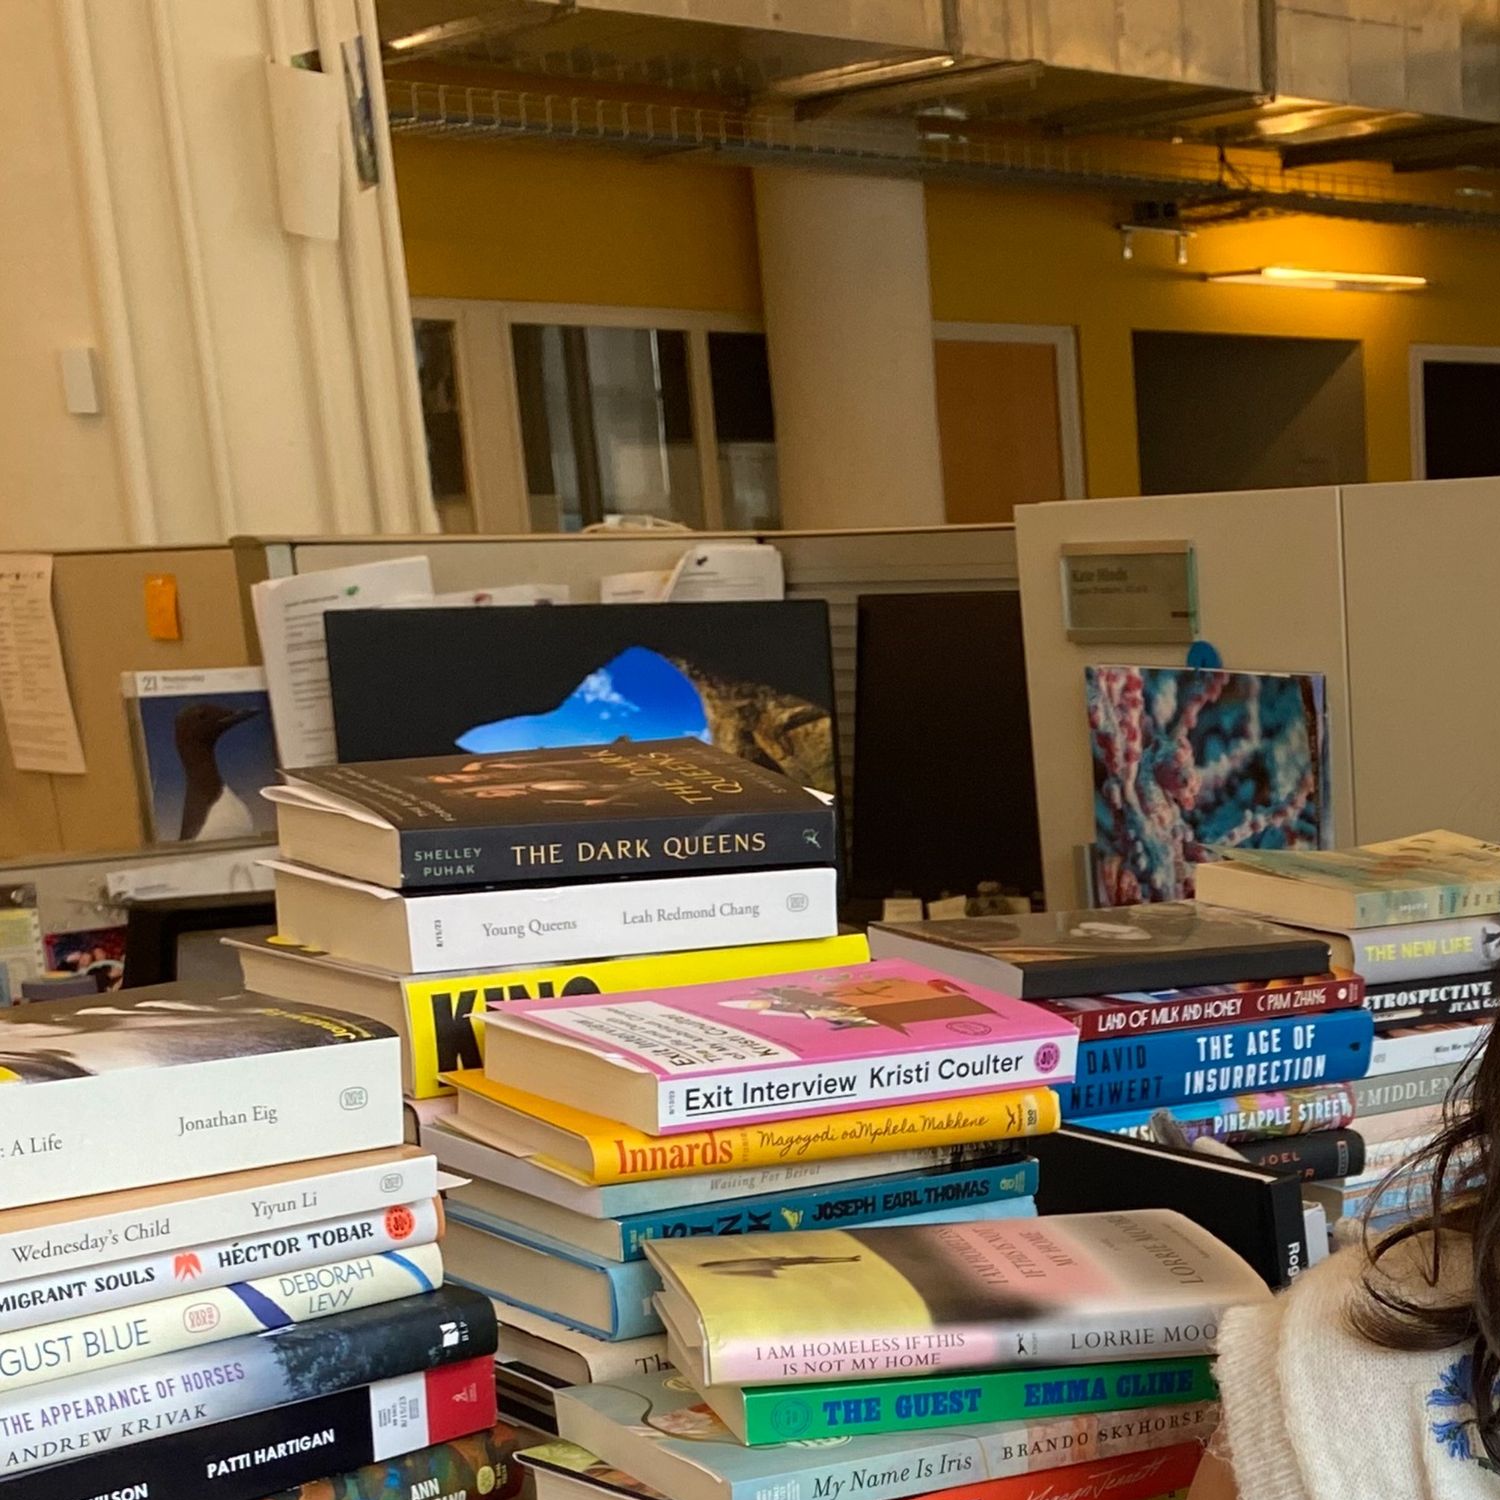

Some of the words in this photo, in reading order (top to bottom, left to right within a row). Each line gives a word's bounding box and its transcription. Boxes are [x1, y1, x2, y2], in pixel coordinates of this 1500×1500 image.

[413, 847, 482, 861] SHELLEY
[511, 844, 565, 866] THE
[578, 839, 652, 862] DARK
[663, 831, 767, 860] QUEENS
[424, 863, 476, 877] PUHAK
[482, 920, 526, 939] Young
[529, 917, 577, 936] Queens
[622, 908, 654, 926] Leah
[656, 903, 716, 923] Redmond
[720, 901, 760, 920] Chang
[1365, 946, 1398, 962] THE
[1402, 941, 1437, 958] NEW
[1441, 937, 1472, 955] LIFE
[1098, 1012, 1125, 1032] LAND
[1129, 1009, 1147, 1027] OF
[1151, 1006, 1179, 1025] MILK
[1182, 1004, 1202, 1019] AND
[1205, 999, 1242, 1017] HONEY
[1256, 997, 1264, 1011] C
[1267, 993, 1290, 1010] PAM
[1294, 988, 1326, 1006] ZHANG
[1197, 1036, 1239, 1060] THE
[1248, 1030, 1281, 1054] AGE
[1294, 1025, 1316, 1050] OF
[684, 1085, 734, 1112] Exit
[742, 1072, 858, 1102] Interview
[868, 1060, 931, 1087] Kristi
[937, 1052, 1024, 1081] Coulter
[1185, 1054, 1326, 1095] INSURRECTION
[11, 1140, 24, 1156] A
[29, 1134, 64, 1153] Life
[178, 1110, 248, 1137] Jonathan
[253, 1105, 278, 1125] Eig
[12, 1228, 120, 1263] Wednesday's
[124, 1219, 171, 1242] Child
[251, 1196, 297, 1219] Yiyun
[301, 1192, 318, 1207] Li
[823, 1400, 881, 1425] THE
[895, 1389, 982, 1417] GUEST
[1025, 1380, 1108, 1407] EMMA
[1117, 1368, 1193, 1399] CLINE
[206, 1451, 252, 1479] PATTI
[255, 1429, 336, 1466] HARTIGAN
[851, 1466, 909, 1491] Name
[918, 1458, 933, 1479] Is
[939, 1454, 972, 1476] Iris
[1002, 1434, 1090, 1462] BRANDO
[1097, 1409, 1206, 1441] SKYHORSE
